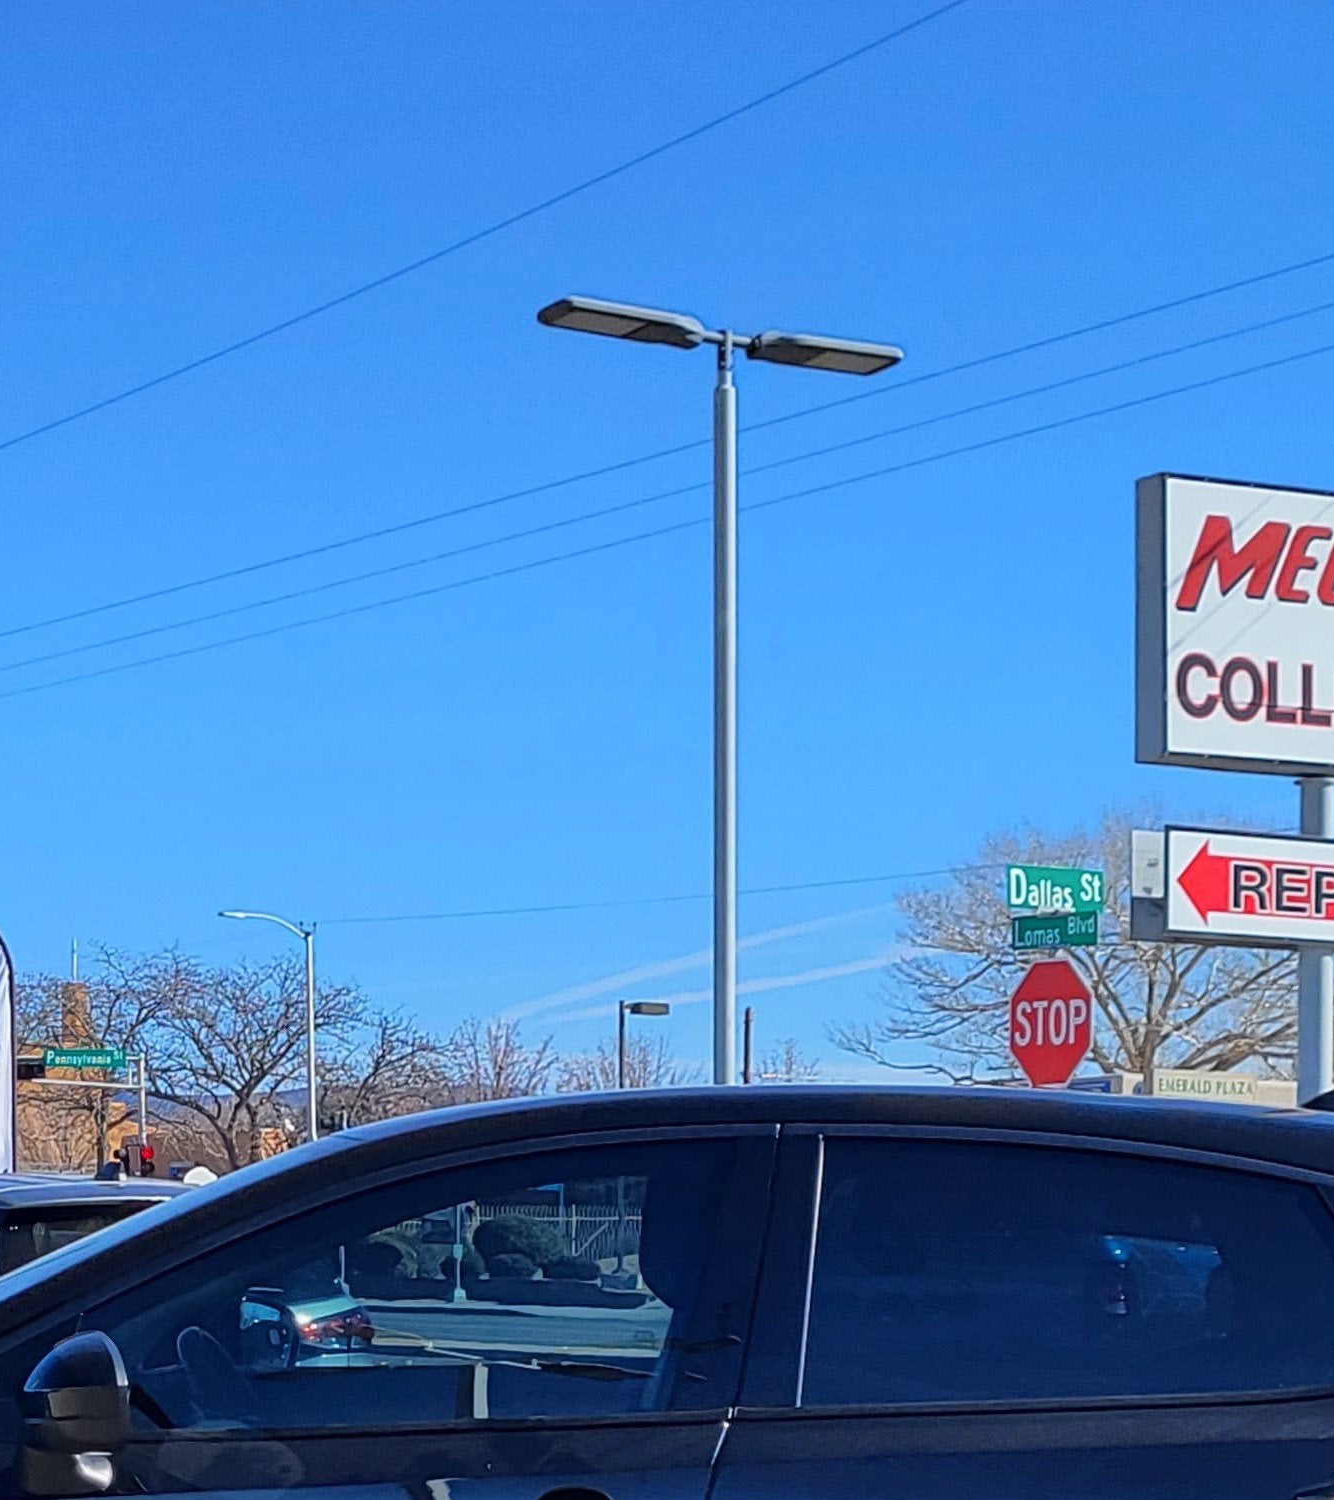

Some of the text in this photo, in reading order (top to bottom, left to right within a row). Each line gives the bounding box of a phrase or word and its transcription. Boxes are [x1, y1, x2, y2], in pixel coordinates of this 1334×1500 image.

[1009, 867, 1102, 910] Dallas St
[1014, 915, 1095, 947] Lomas Blvd
[1013, 998, 1088, 1047] STOP
[46, 1050, 124, 1067] Pennsylvania St
[1158, 1077, 1253, 1095] EMERALD PLAZA
